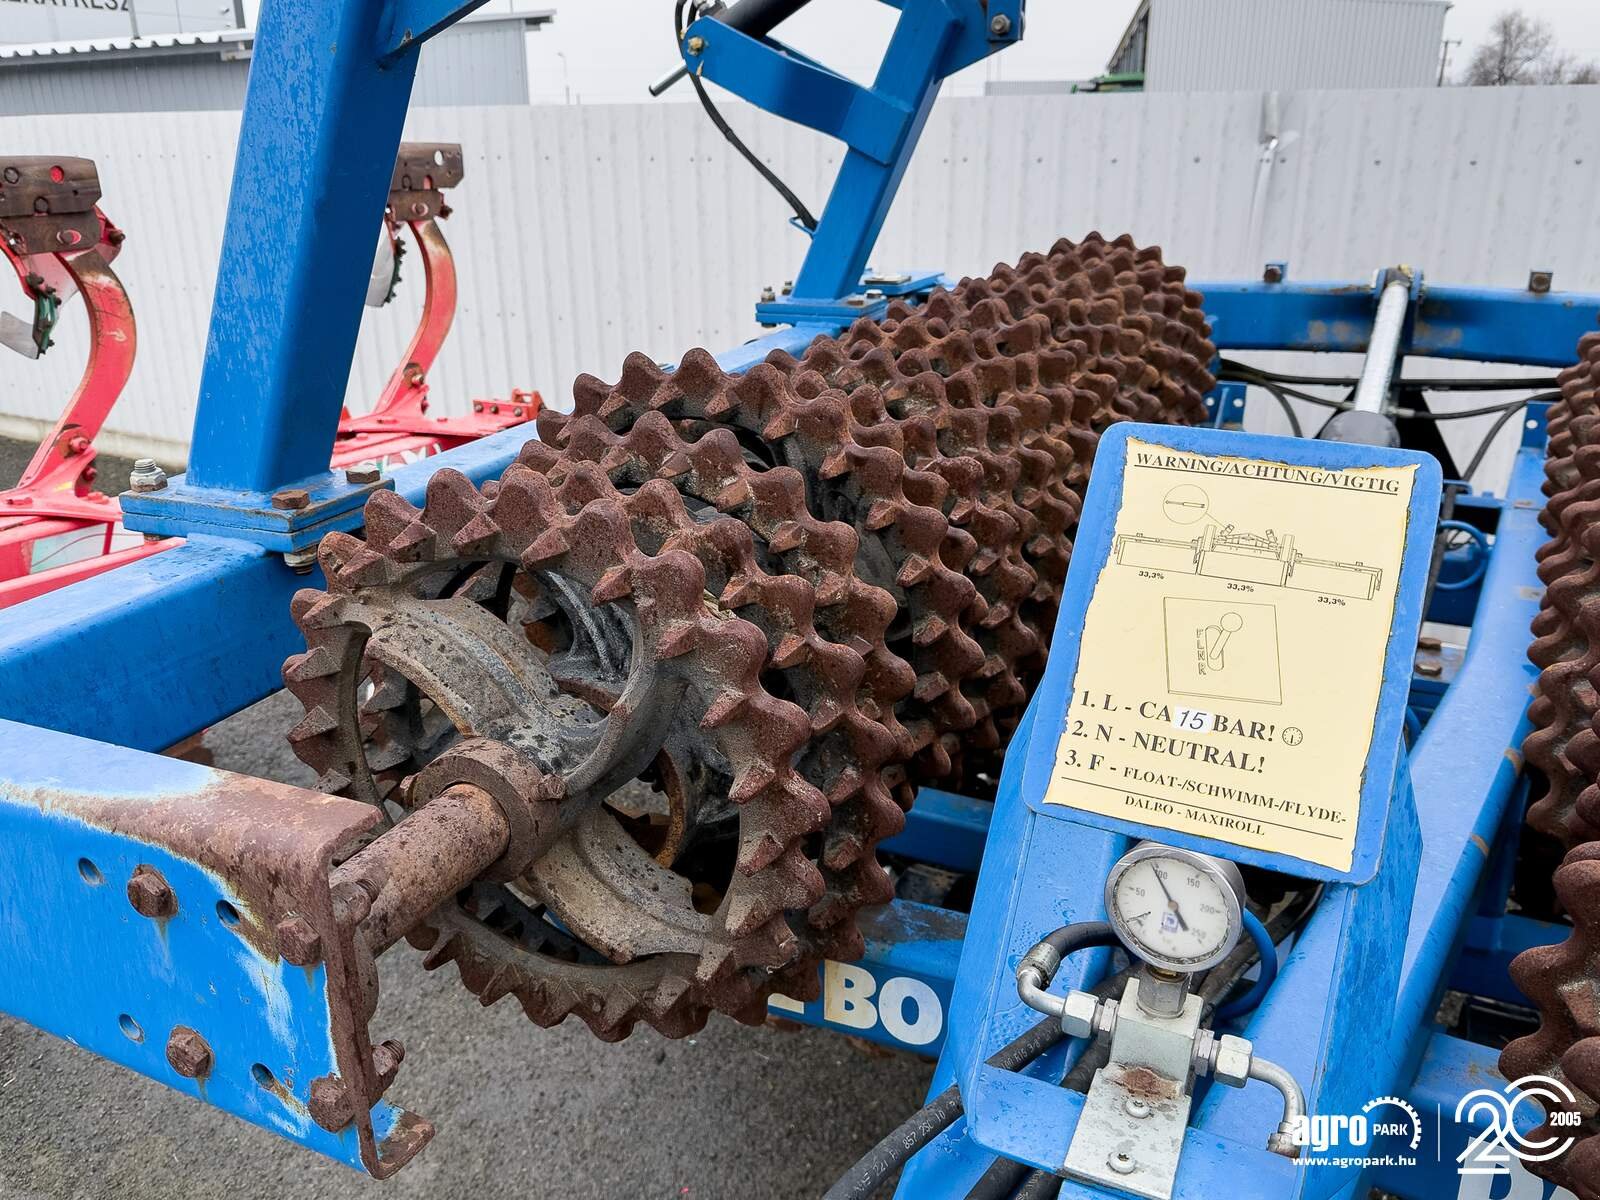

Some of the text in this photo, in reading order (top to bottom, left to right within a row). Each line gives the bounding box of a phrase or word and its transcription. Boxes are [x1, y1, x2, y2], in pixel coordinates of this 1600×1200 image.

[1135, 452, 1400, 493] WARNING/ACHTUNG/VIGTIG
[1138, 570, 1165, 580] 33,3%
[1226, 582, 1255, 593] 33,3%
[1317, 595, 1346, 606] 33,3%
[1081, 690, 1096, 709] 1.
[1102, 693, 1119, 713] L
[1139, 700, 1171, 722] CA
[1177, 709, 1208, 731] 15
[1212, 713, 1276, 742] BAR!
[1071, 720, 1088, 739] 2.
[1095, 723, 1114, 742] N
[1132, 731, 1265, 774] NEUTRAL!
[1064, 749, 1082, 769] 3.
[1088, 753, 1105, 771] F
[1123, 766, 1347, 823] FLOAT-/SCHWIMM-/FLYDE-
[1125, 794, 1174, 816] DALBO
[1185, 811, 1265, 836] MAXIROLL
[1187, 877, 1201, 889] 150
[1135, 887, 1146, 898] 50
[902, 1131, 918, 1149] 857
